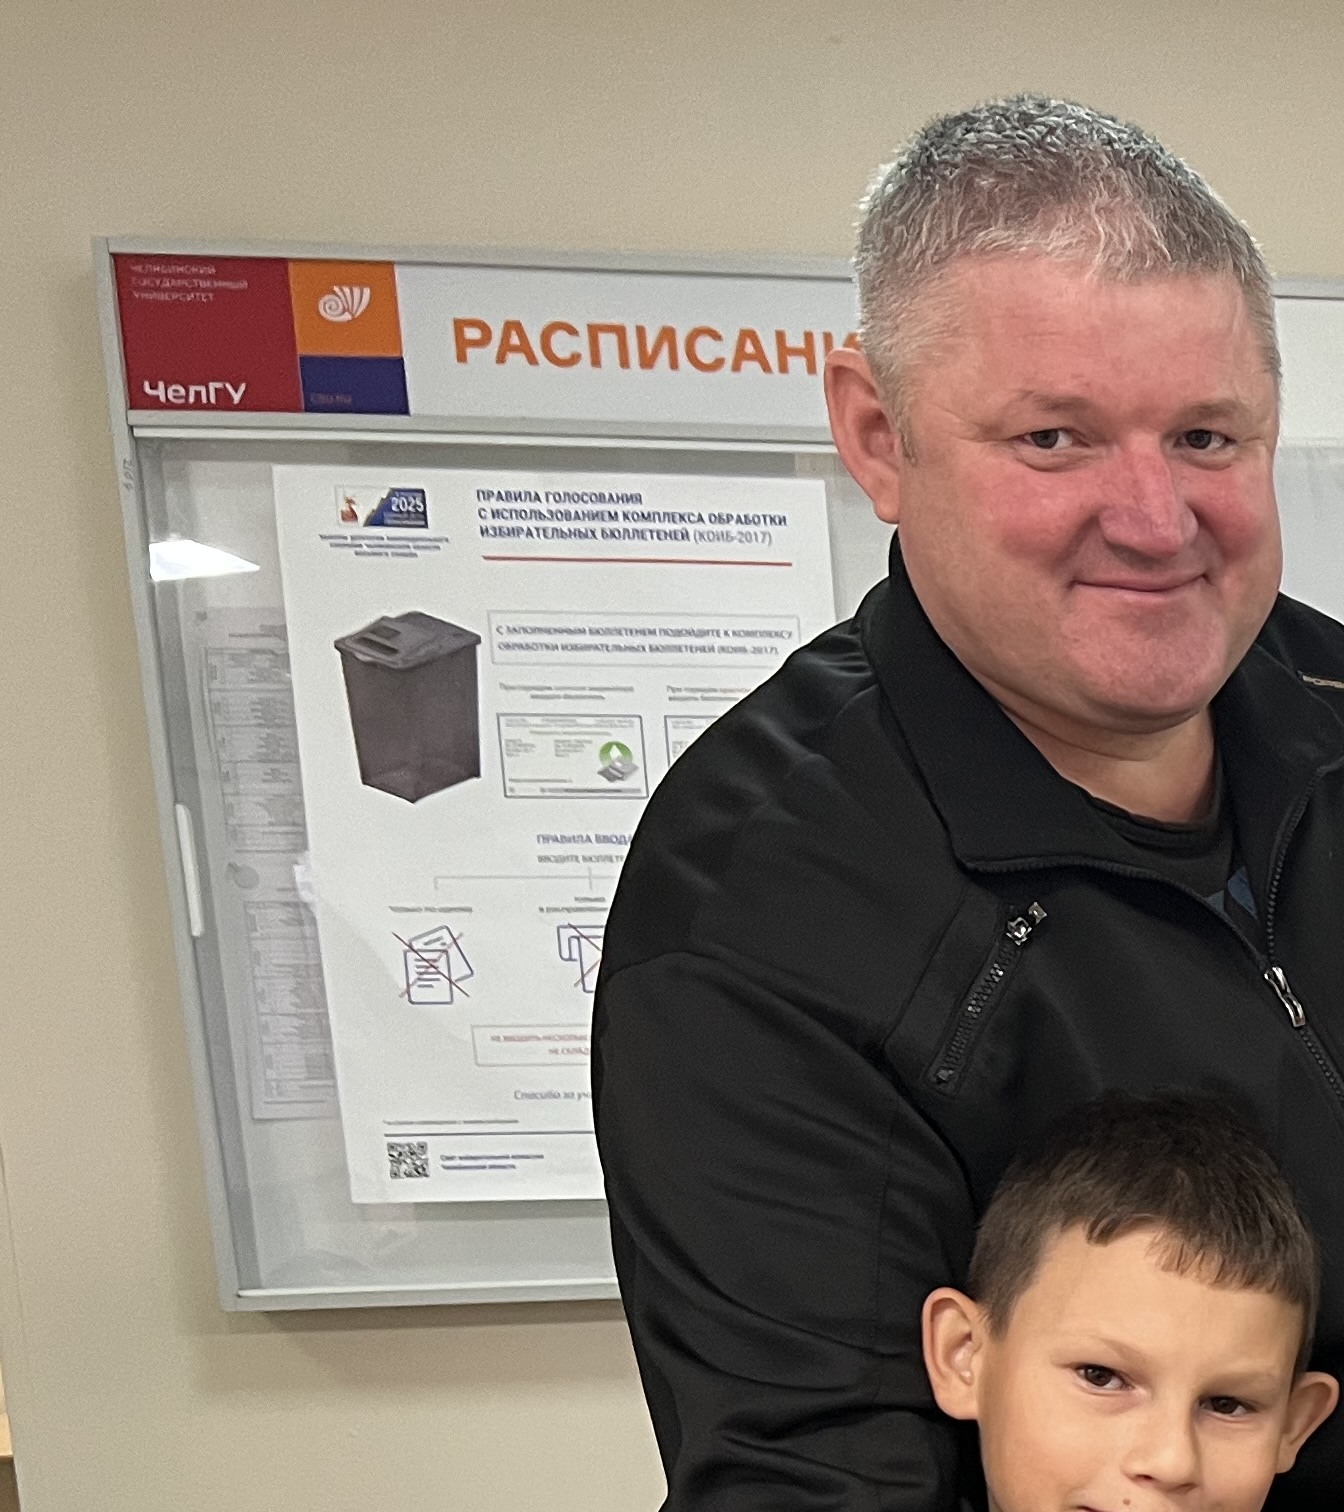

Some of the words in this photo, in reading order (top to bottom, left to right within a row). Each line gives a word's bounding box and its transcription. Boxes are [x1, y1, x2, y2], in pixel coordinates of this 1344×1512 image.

[143, 380, 247, 405] ЧелГУ
[391, 496, 424, 512] 2025
[476, 489, 541, 504] ПРАВИЛА
[545, 491, 642, 506] ГОЛОСОВАНИЯ
[478, 508, 487, 520] С
[491, 508, 619, 523] ИСПОЛЬЗОВАНИЕМ
[623, 511, 705, 525] КОМПЛЕКСА
[709, 513, 787, 527] ОБРАБОТКИ
[480, 525, 598, 541] ИЗБИРАТЕЛЬНЫХ
[601, 526, 690, 542] БЮЛЛЕТЕНЕЙ
[694, 530, 773, 547] (КОИБ-2017)
